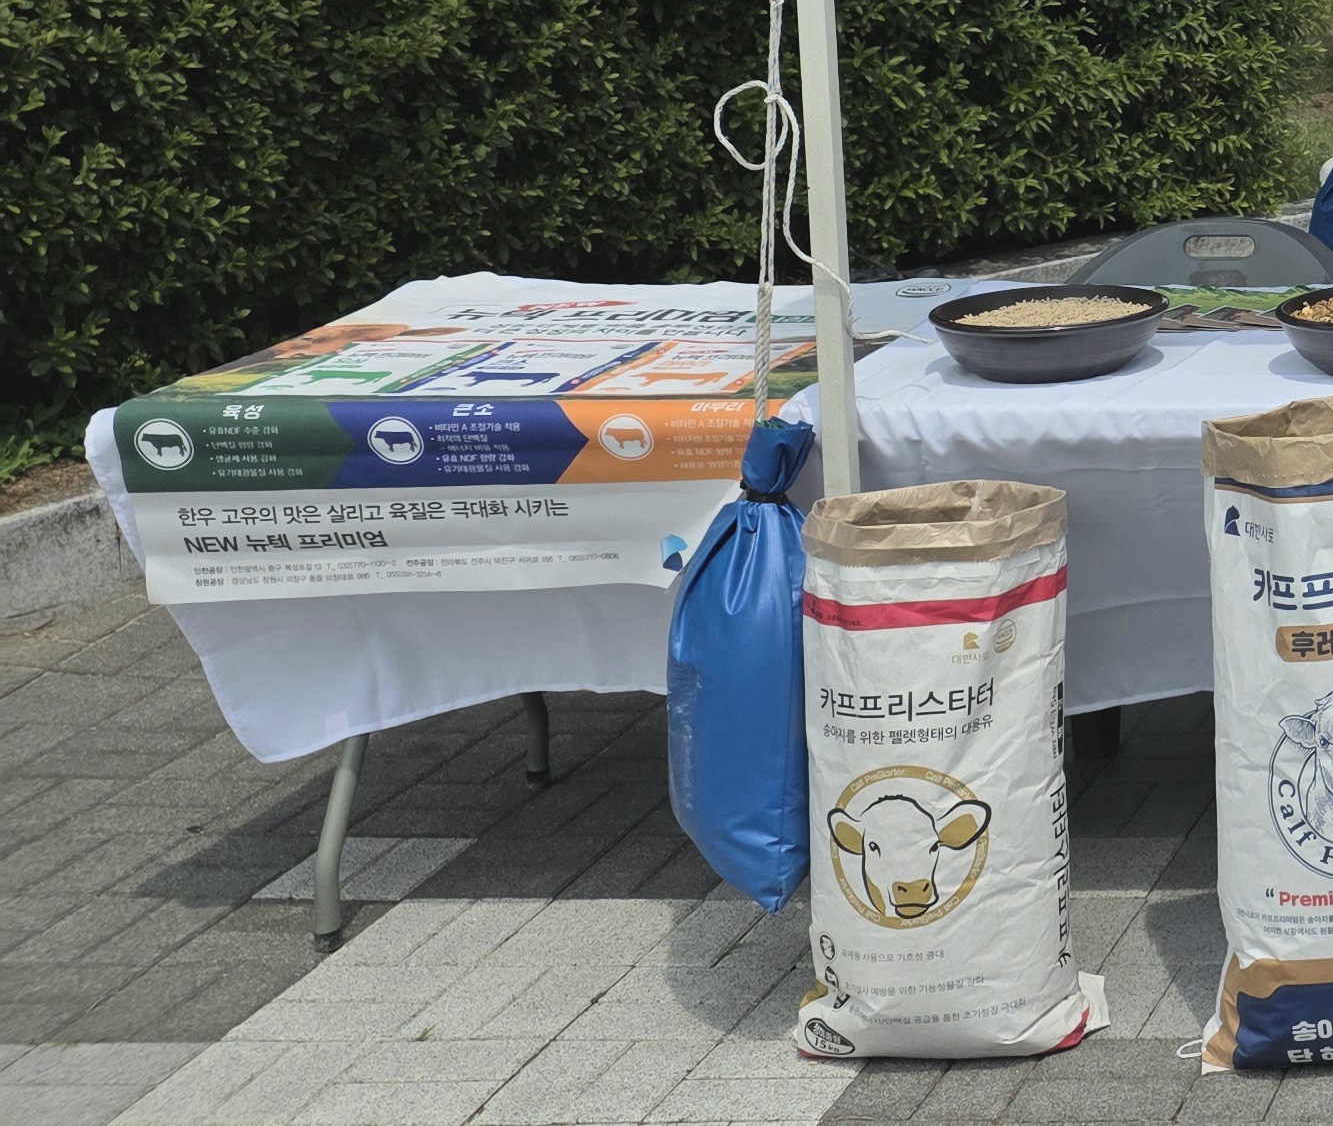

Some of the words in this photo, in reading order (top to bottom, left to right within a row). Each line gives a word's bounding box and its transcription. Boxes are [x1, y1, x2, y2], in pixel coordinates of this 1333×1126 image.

[222, 404, 265, 420] 육성
[453, 403, 495, 417] 큰소
[691, 402, 745, 413] 마무리
[177, 506, 216, 527] 한우
[221, 505, 278, 526] 고유의
[283, 504, 321, 524] 맛은
[326, 503, 384, 524] 살리고
[389, 501, 446, 521] 육질은
[451, 499, 509, 519] 극대화
[514, 498, 569, 518] 시키는
[184, 536, 238, 554] NEW
[246, 533, 293, 553] 뉴텍
[297, 530, 389, 550] 프리미엄
[1244, 521, 1275, 544] 대한사료
[820, 677, 994, 721] 카프프리스타터
[823, 723, 857, 745] 송아지를
[859, 730, 885, 745] 위한
[888, 725, 957, 746] 펠렛형태의
[961, 713, 994, 737] 대용유
[1278, 779, 1317, 847] Calf
[898, 985, 917, 996] 위한
[1287, 1048, 1314, 1064] 단
